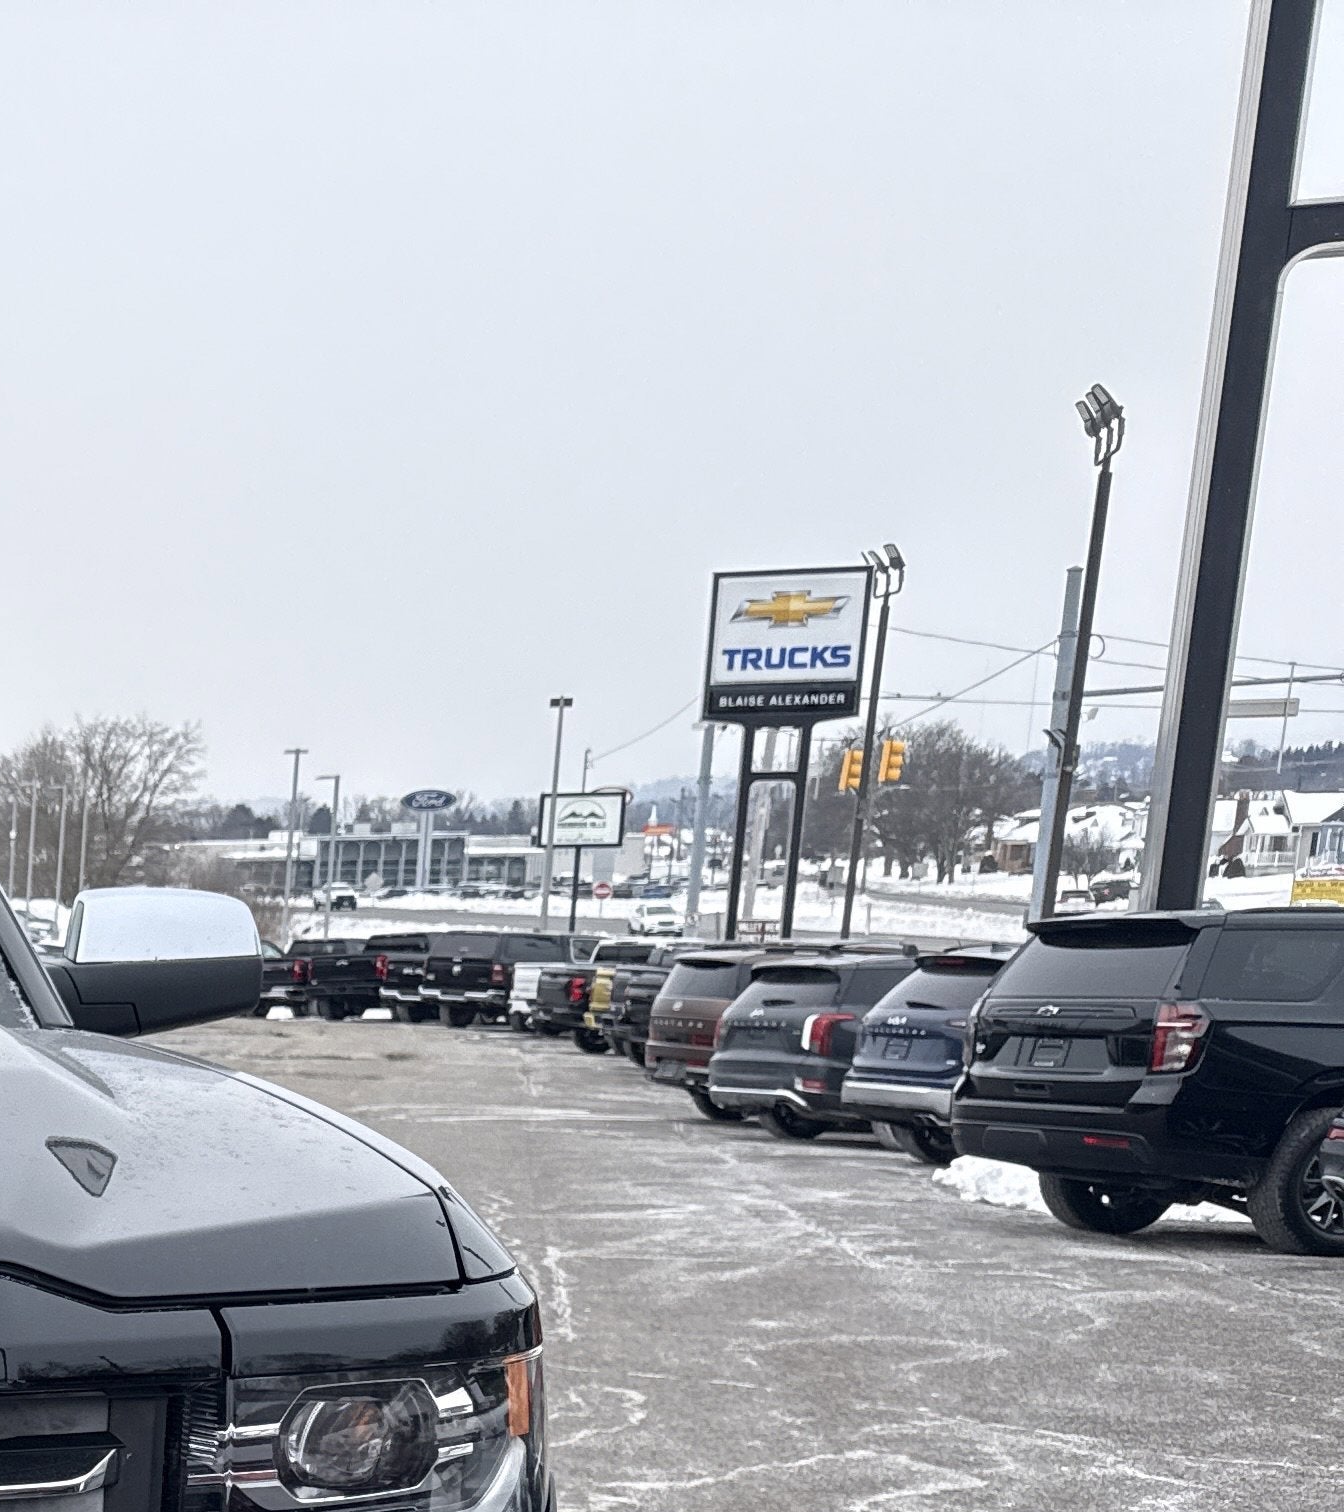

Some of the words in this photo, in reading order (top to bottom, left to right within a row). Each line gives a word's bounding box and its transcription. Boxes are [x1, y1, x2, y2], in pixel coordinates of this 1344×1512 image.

[722, 645, 852, 671] TRUCKS
[718, 695, 765, 708] BLAISE
[769, 693, 845, 706] ALEXANDER
